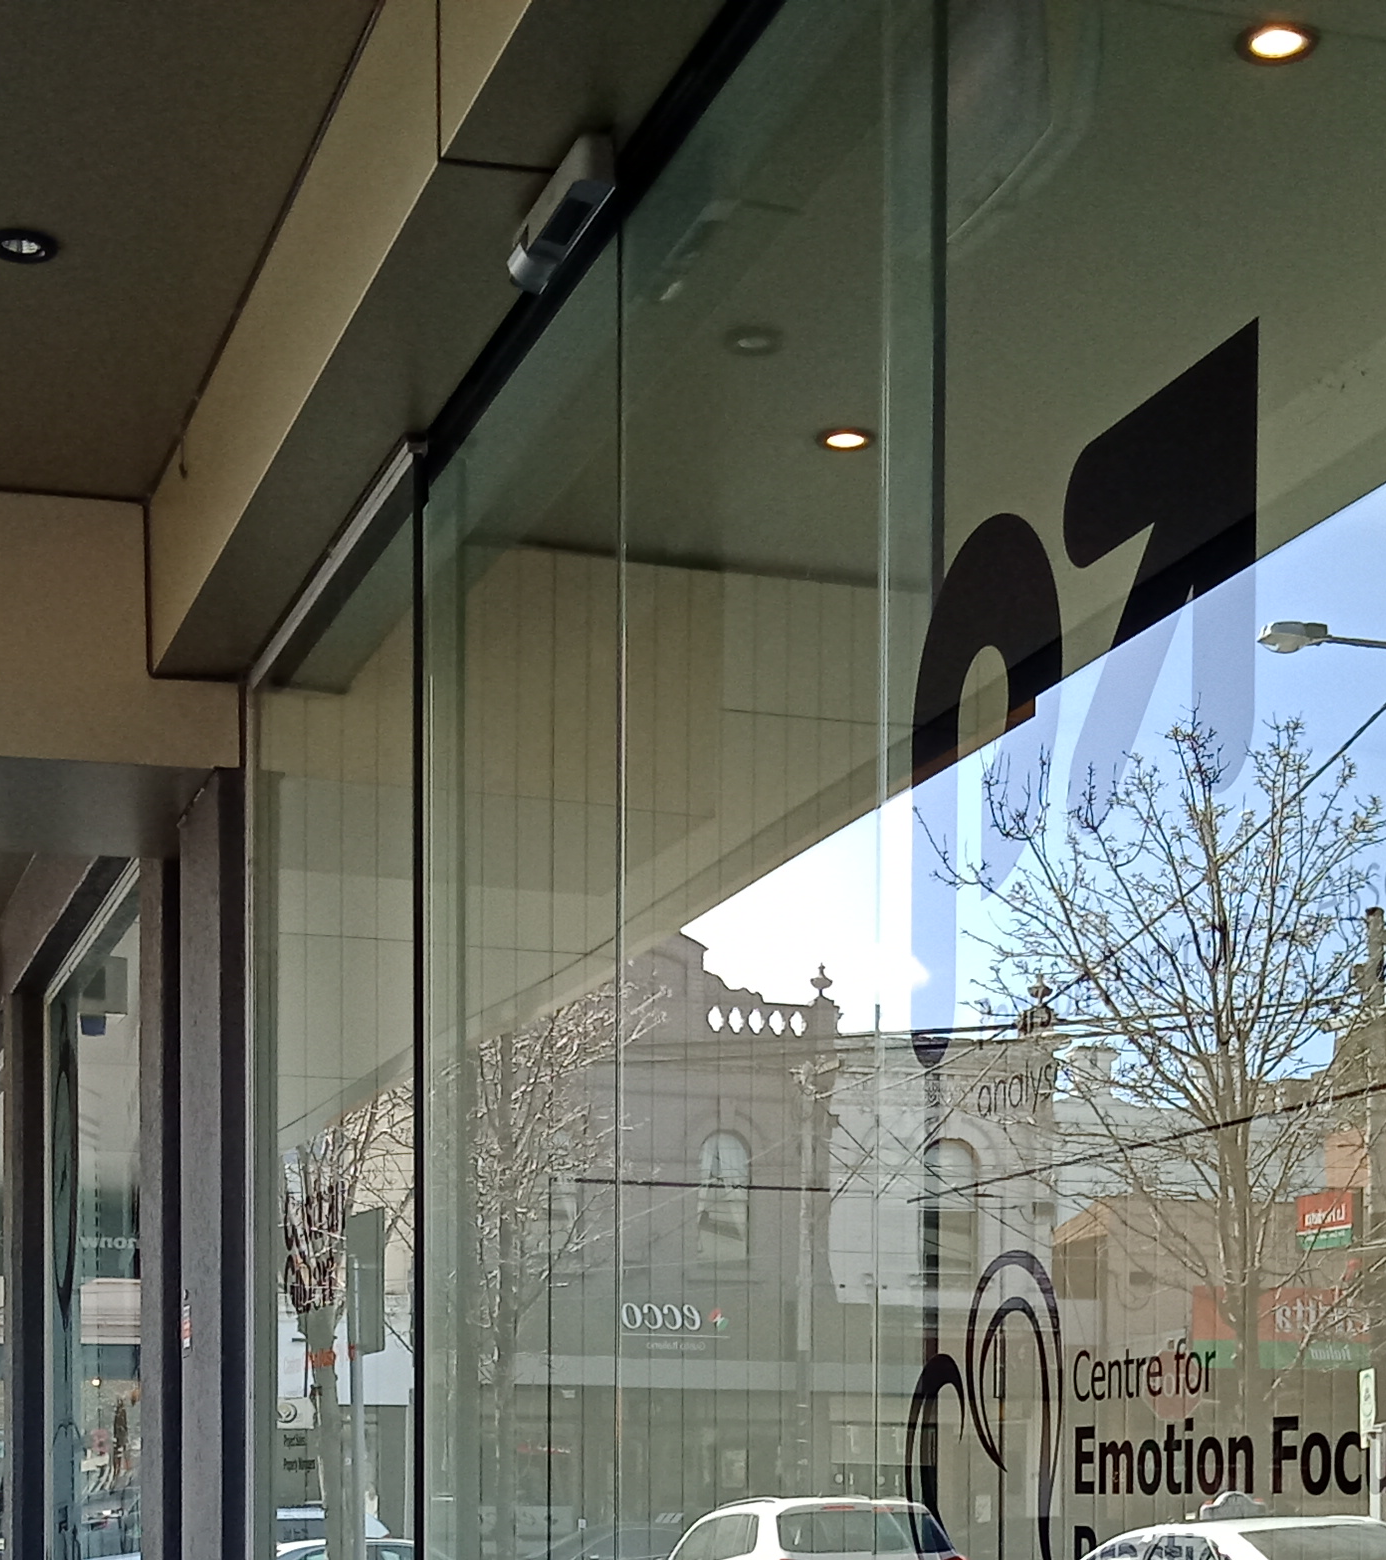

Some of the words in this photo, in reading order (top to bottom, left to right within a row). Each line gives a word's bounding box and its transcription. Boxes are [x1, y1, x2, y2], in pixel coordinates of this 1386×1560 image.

[1073, 1347, 1163, 1402] Centre
[1174, 1337, 1216, 1396] for
[1073, 1416, 1254, 1496] Emotion
